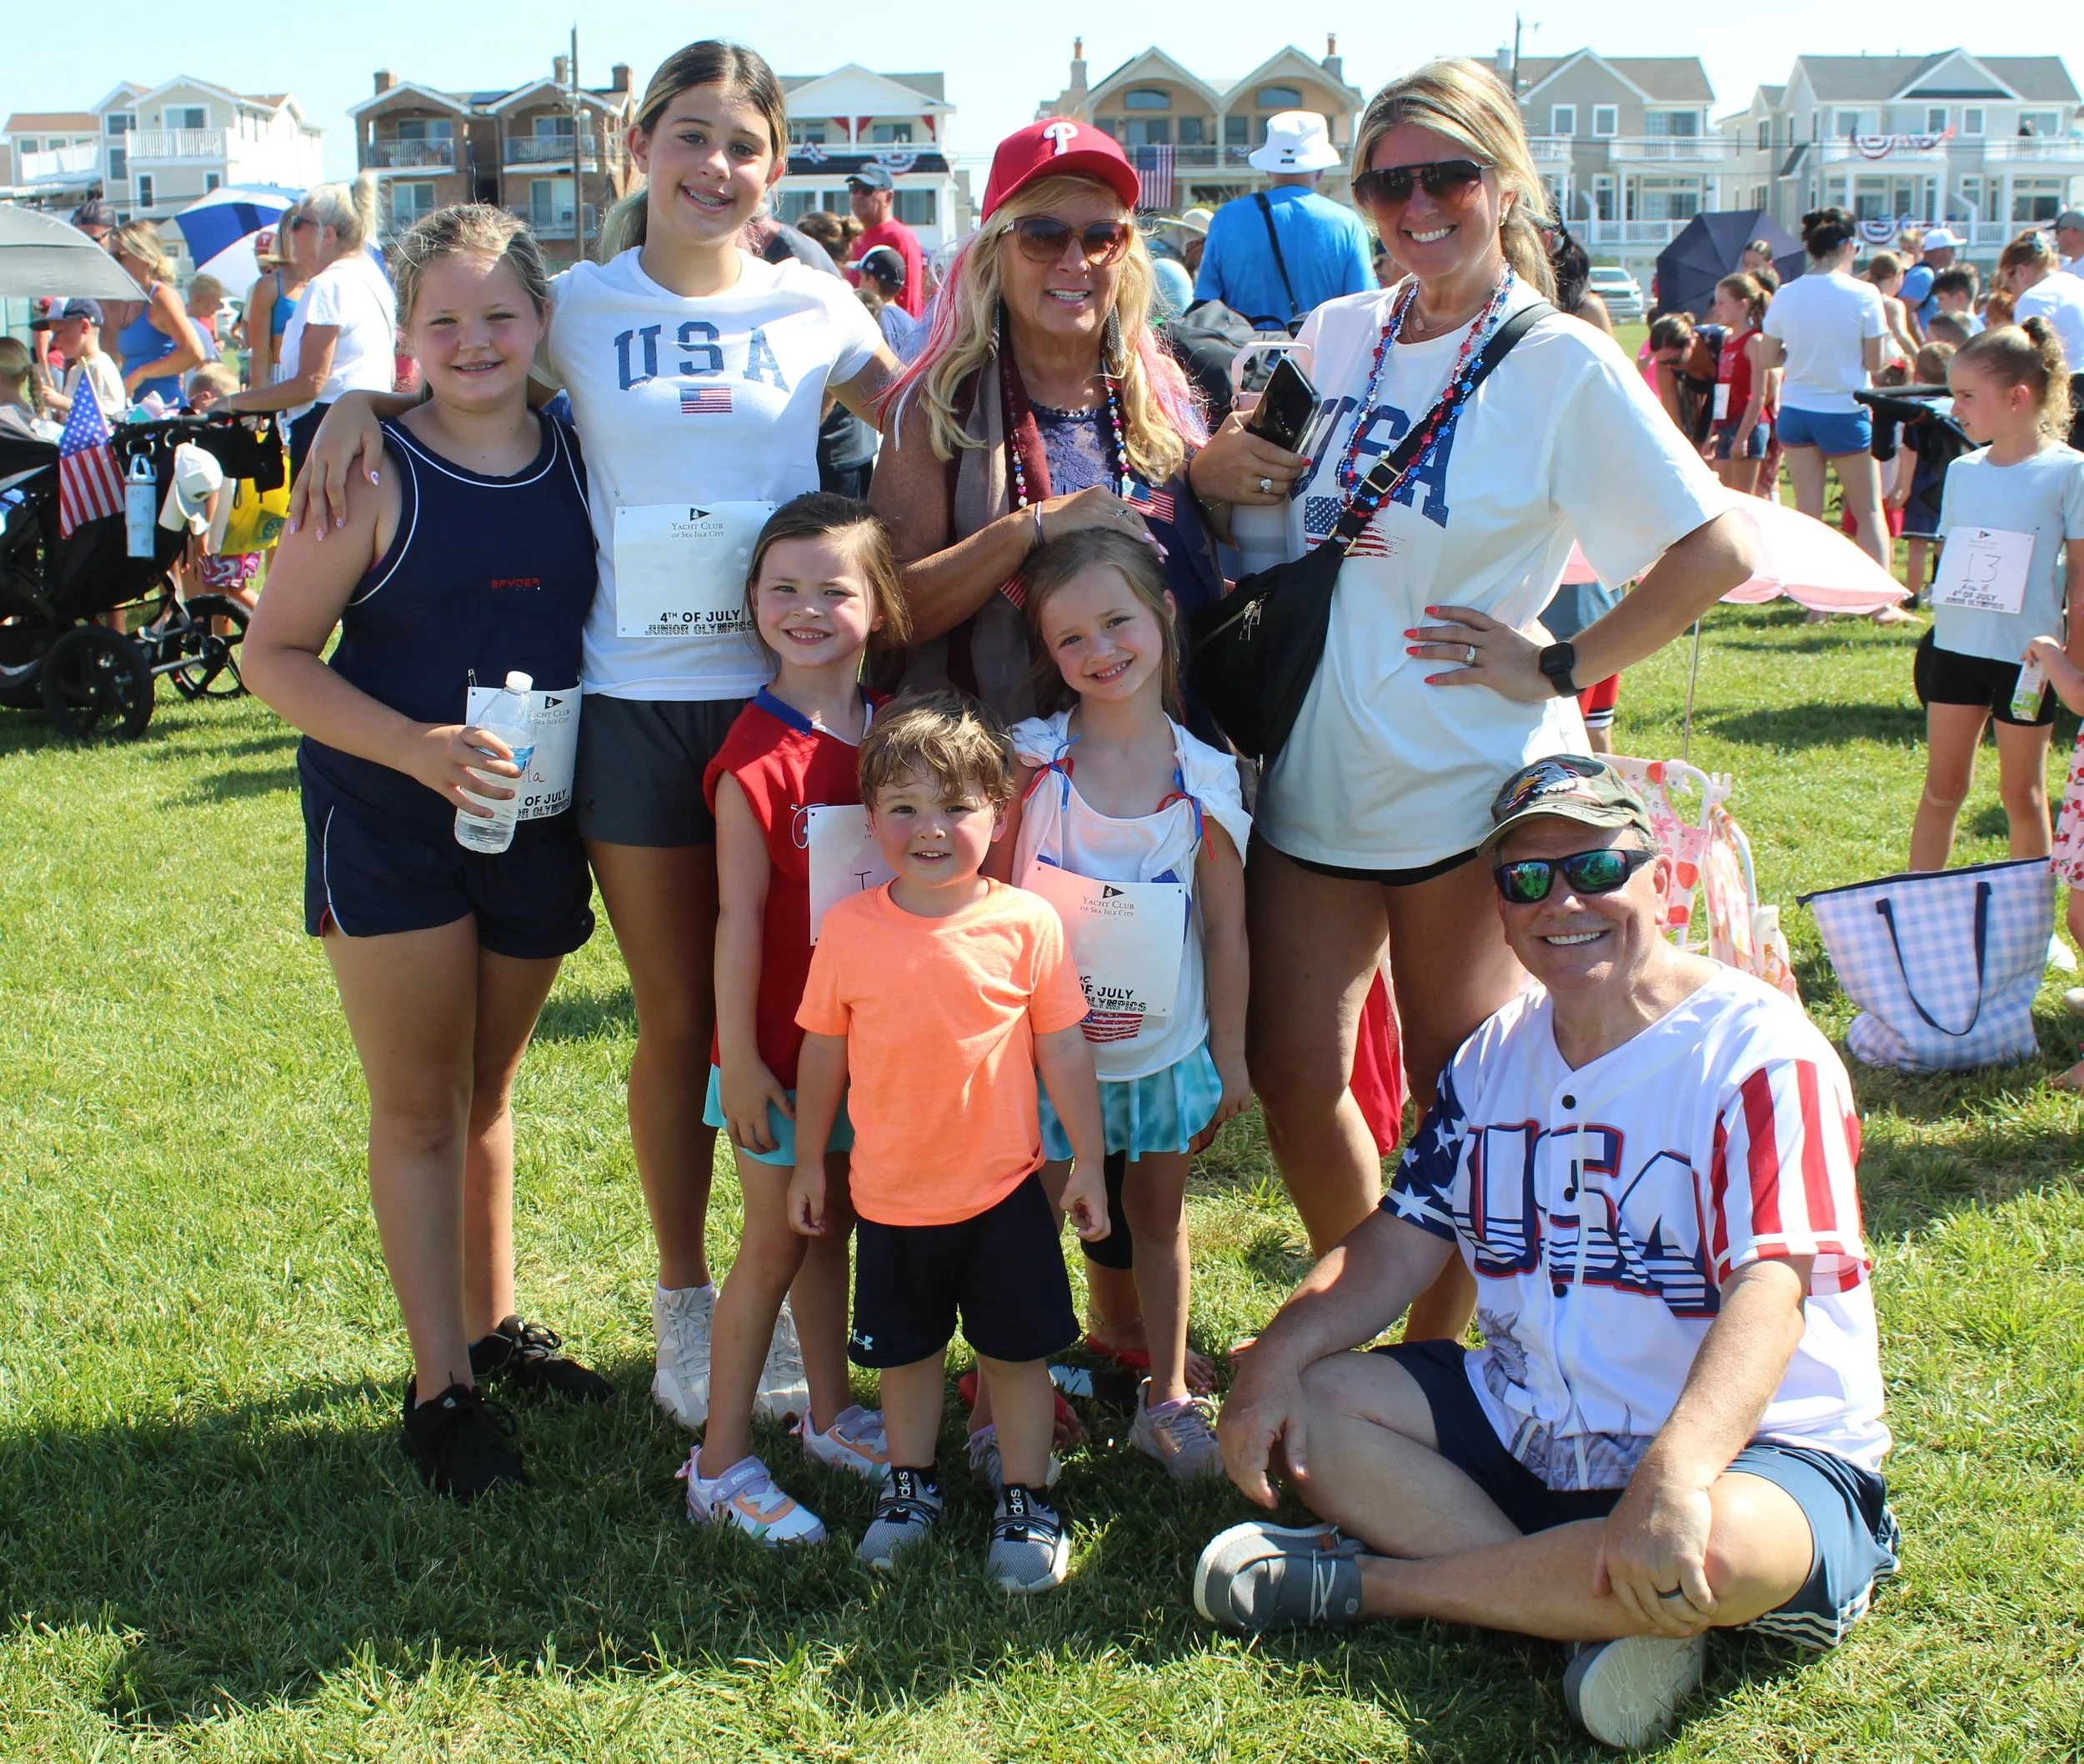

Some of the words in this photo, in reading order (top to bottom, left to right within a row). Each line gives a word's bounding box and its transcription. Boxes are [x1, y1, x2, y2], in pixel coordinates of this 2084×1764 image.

[1043, 122, 1079, 156] P
[614, 321, 791, 394] USA
[1290, 396, 1459, 529] USA
[671, 522, 699, 530] YACHT
[700, 521, 724, 530] CLUB
[1961, 553, 2002, 584] 13
[490, 578, 541, 589] SPYDER
[1963, 590, 1975, 599] OF
[1975, 593, 1997, 601] JULY
[660, 612, 678, 623] 4TH
[682, 612, 701, 623] OF
[705, 609, 741, 622] JULY
[644, 624, 689, 635] JUNIOR
[694, 619, 754, 635] OLYMPICS
[524, 794, 542, 807] OF
[544, 787, 567, 804] JULY
[1082, 896, 1111, 908] YACHT
[1112, 900, 1135, 910] CLUB
[1090, 906, 1102, 915] SEA
[1097, 986, 1135, 1000] JULY
[1451, 1119, 1721, 1319] USA
